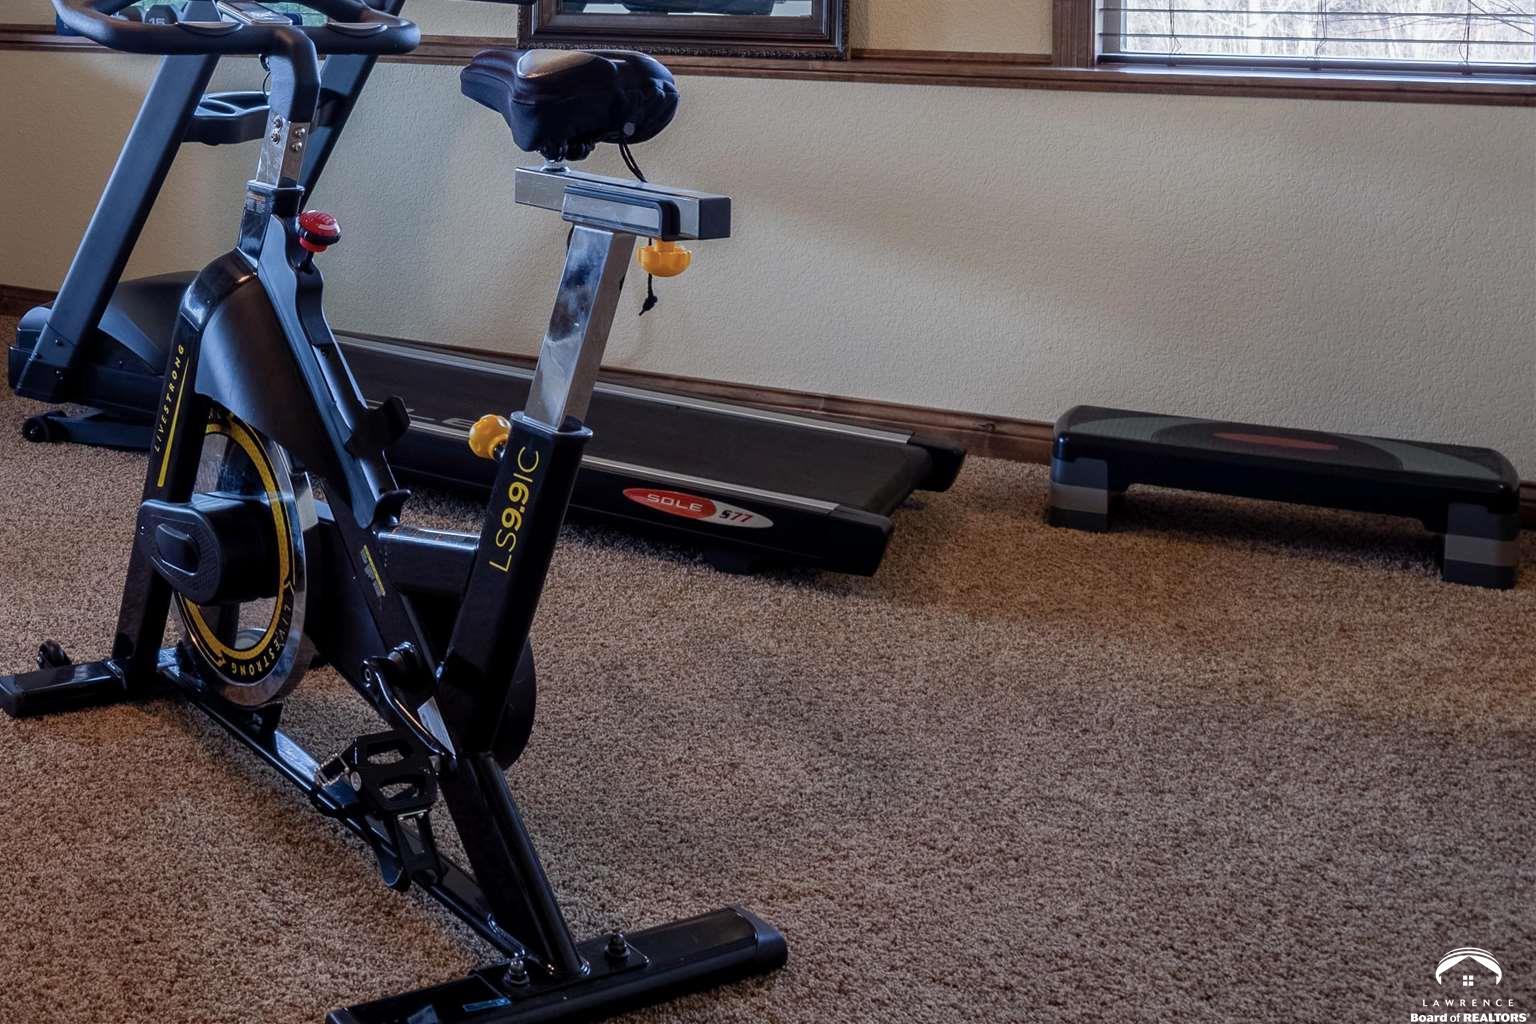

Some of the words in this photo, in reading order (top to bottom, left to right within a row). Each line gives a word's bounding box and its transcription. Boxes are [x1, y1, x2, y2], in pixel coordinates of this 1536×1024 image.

[154, 344, 185, 452] LIVESTRONG
[647, 493, 704, 512] SOLE
[232, 602, 292, 676] LIVESTRONG
